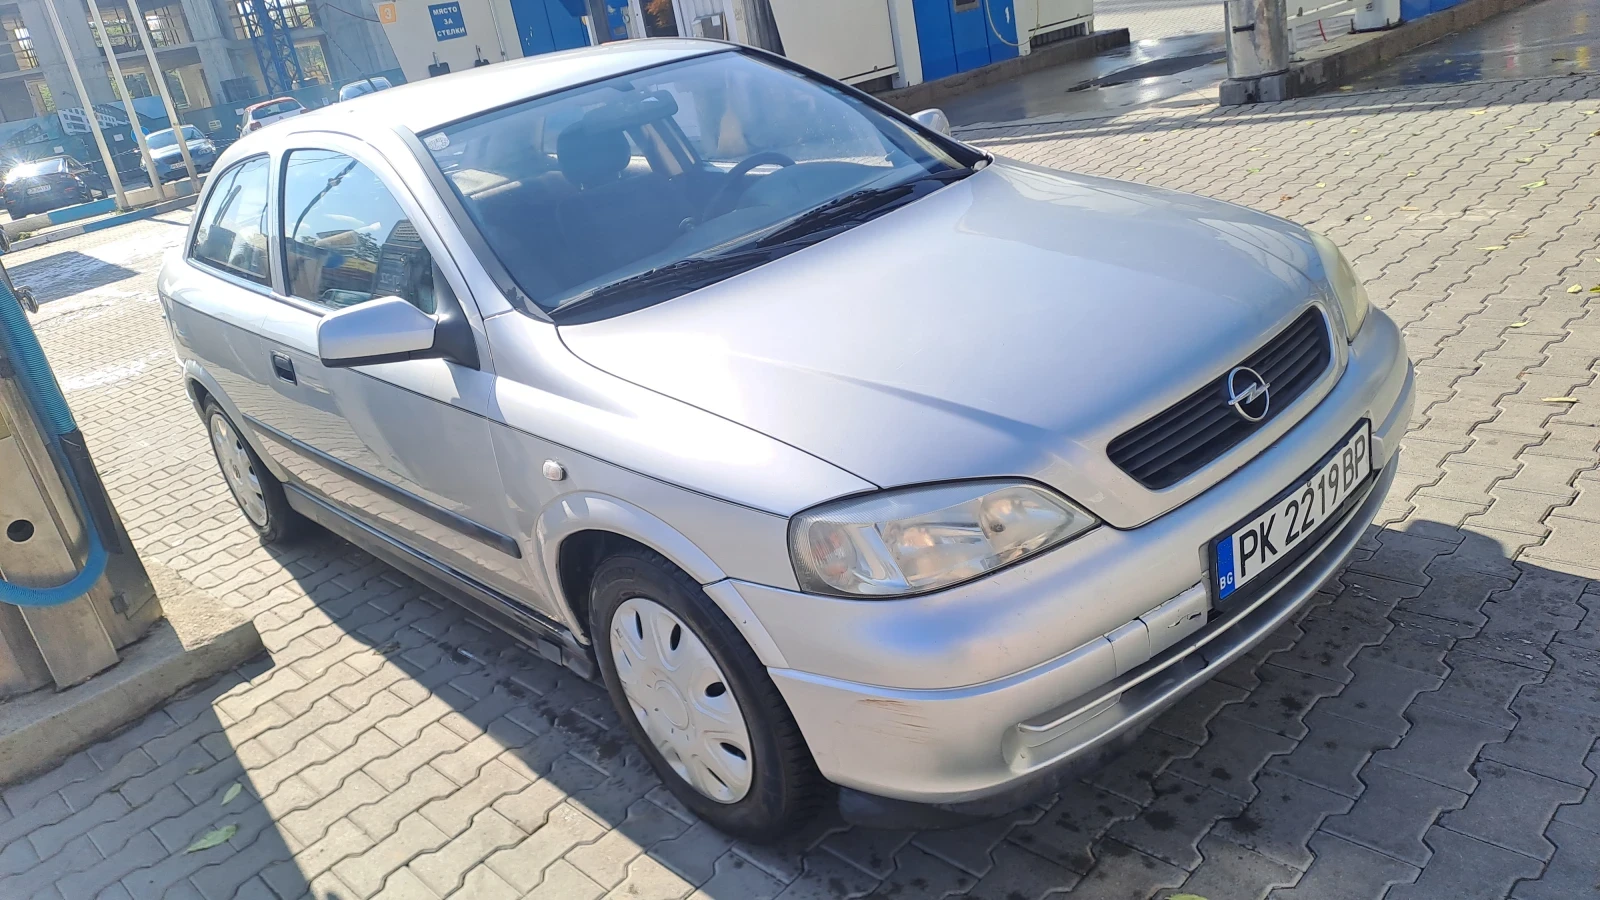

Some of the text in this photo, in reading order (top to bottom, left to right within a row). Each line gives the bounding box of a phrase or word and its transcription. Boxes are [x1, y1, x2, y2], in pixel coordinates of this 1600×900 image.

[384, 8, 391, 19] 3
[432, 6, 458, 15] МЯСТО
[436, 27, 465, 37] СТЕЛКИ
[1219, 434, 1366, 590] BG PK 2219 BP
